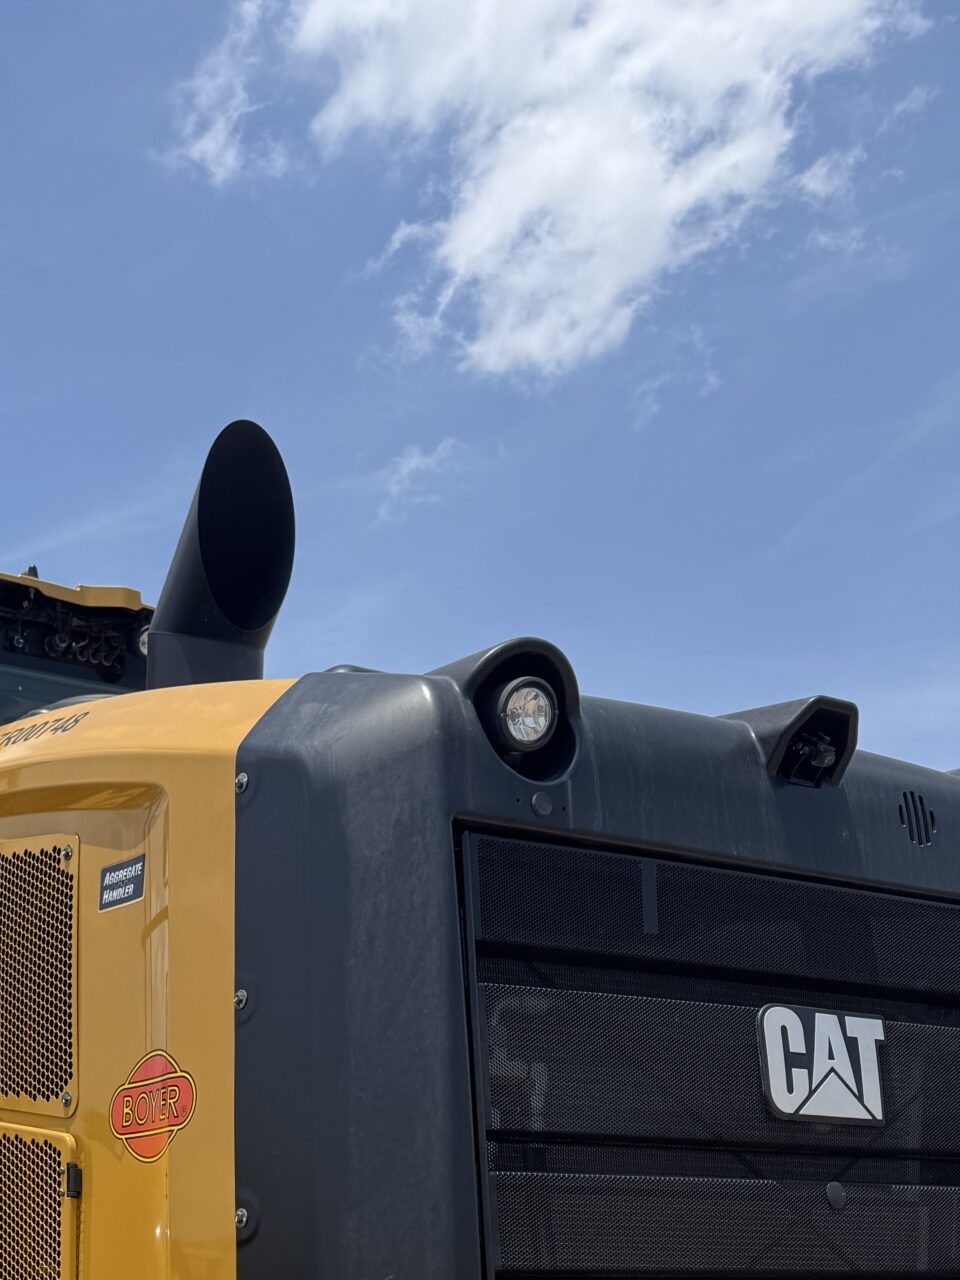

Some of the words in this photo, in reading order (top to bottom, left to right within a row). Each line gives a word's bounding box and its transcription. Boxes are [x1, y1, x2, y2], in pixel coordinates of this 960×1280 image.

[103, 862, 143, 887] AGGREGATE
[102, 883, 134, 904] HANDLER
[763, 1006, 885, 1120] CAT
[122, 1085, 179, 1128] BOYER
